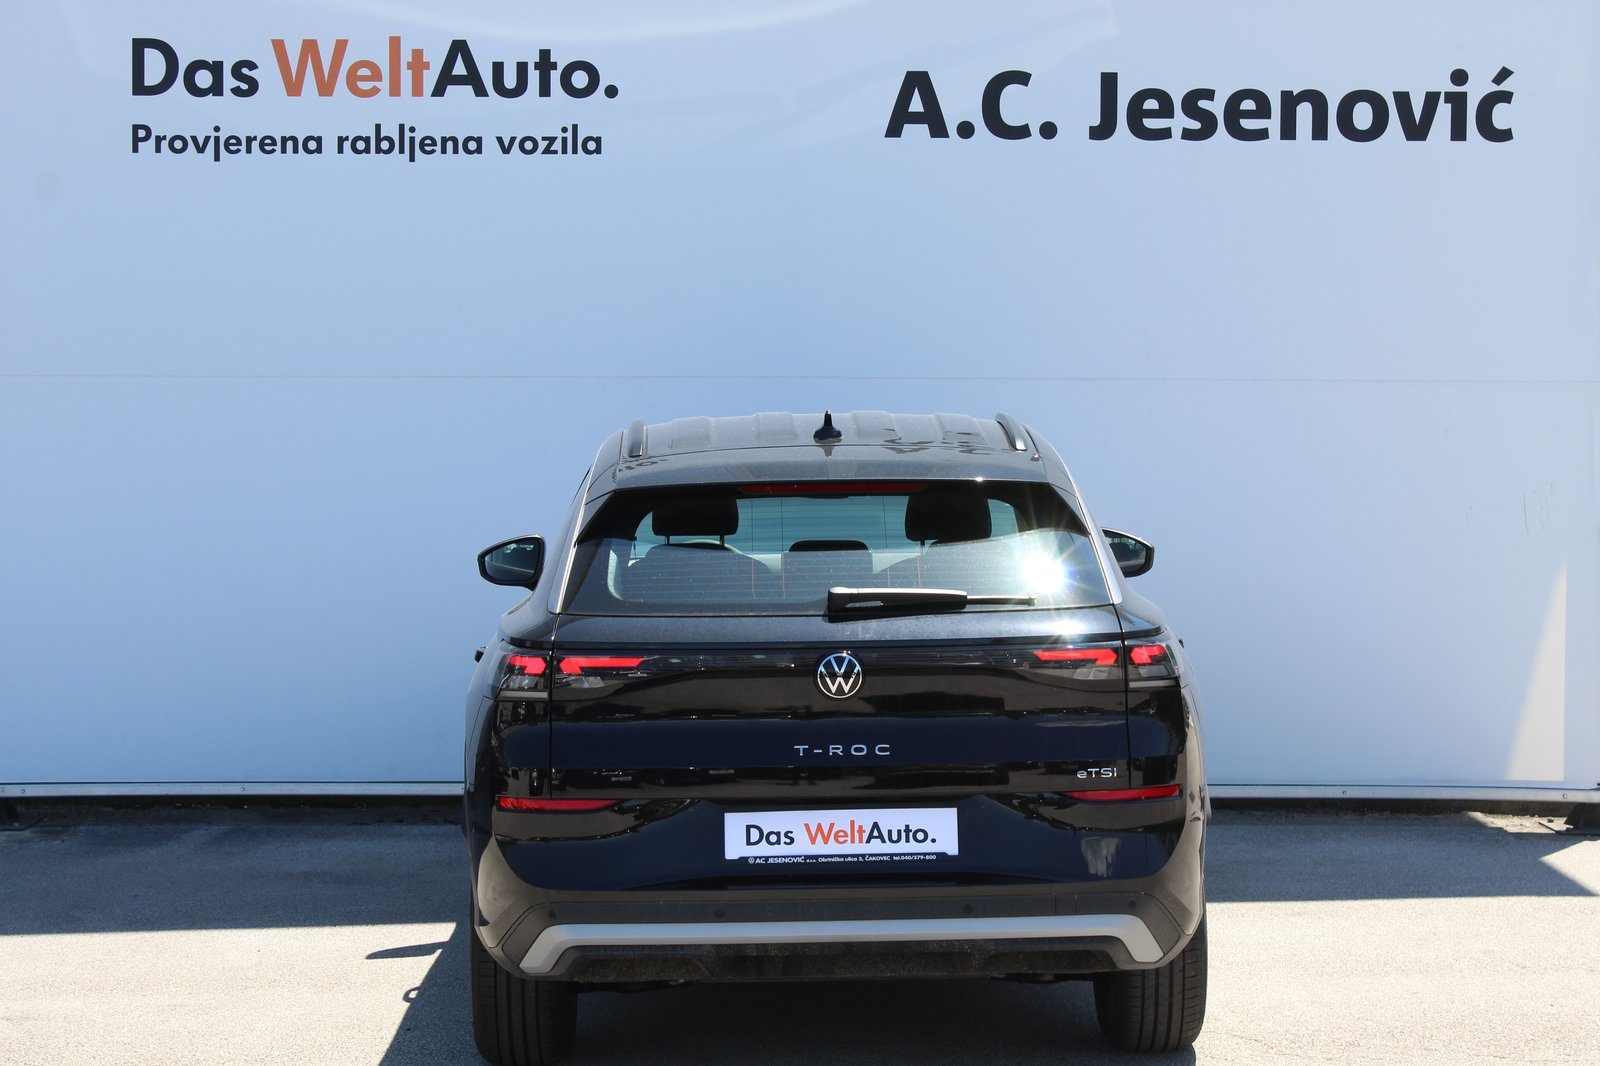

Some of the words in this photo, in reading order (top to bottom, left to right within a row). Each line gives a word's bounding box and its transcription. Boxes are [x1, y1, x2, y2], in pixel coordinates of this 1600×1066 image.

[132, 38, 260, 98] Das
[271, 35, 619, 98] WeltAuto.
[885, 70, 1057, 140] A.C.
[1089, 66, 1514, 143] Jesenović
[132, 124, 323, 162] Provjerena
[338, 124, 483, 162] rabljena
[496, 124, 602, 156] vozila
[794, 744, 890, 756] T-ROC
[1076, 767, 1117, 779] eTSI
[745, 824, 795, 846] Das
[803, 819, 937, 845] WeltAuto.
[767, 856, 805, 864] JESENOVIĆ
